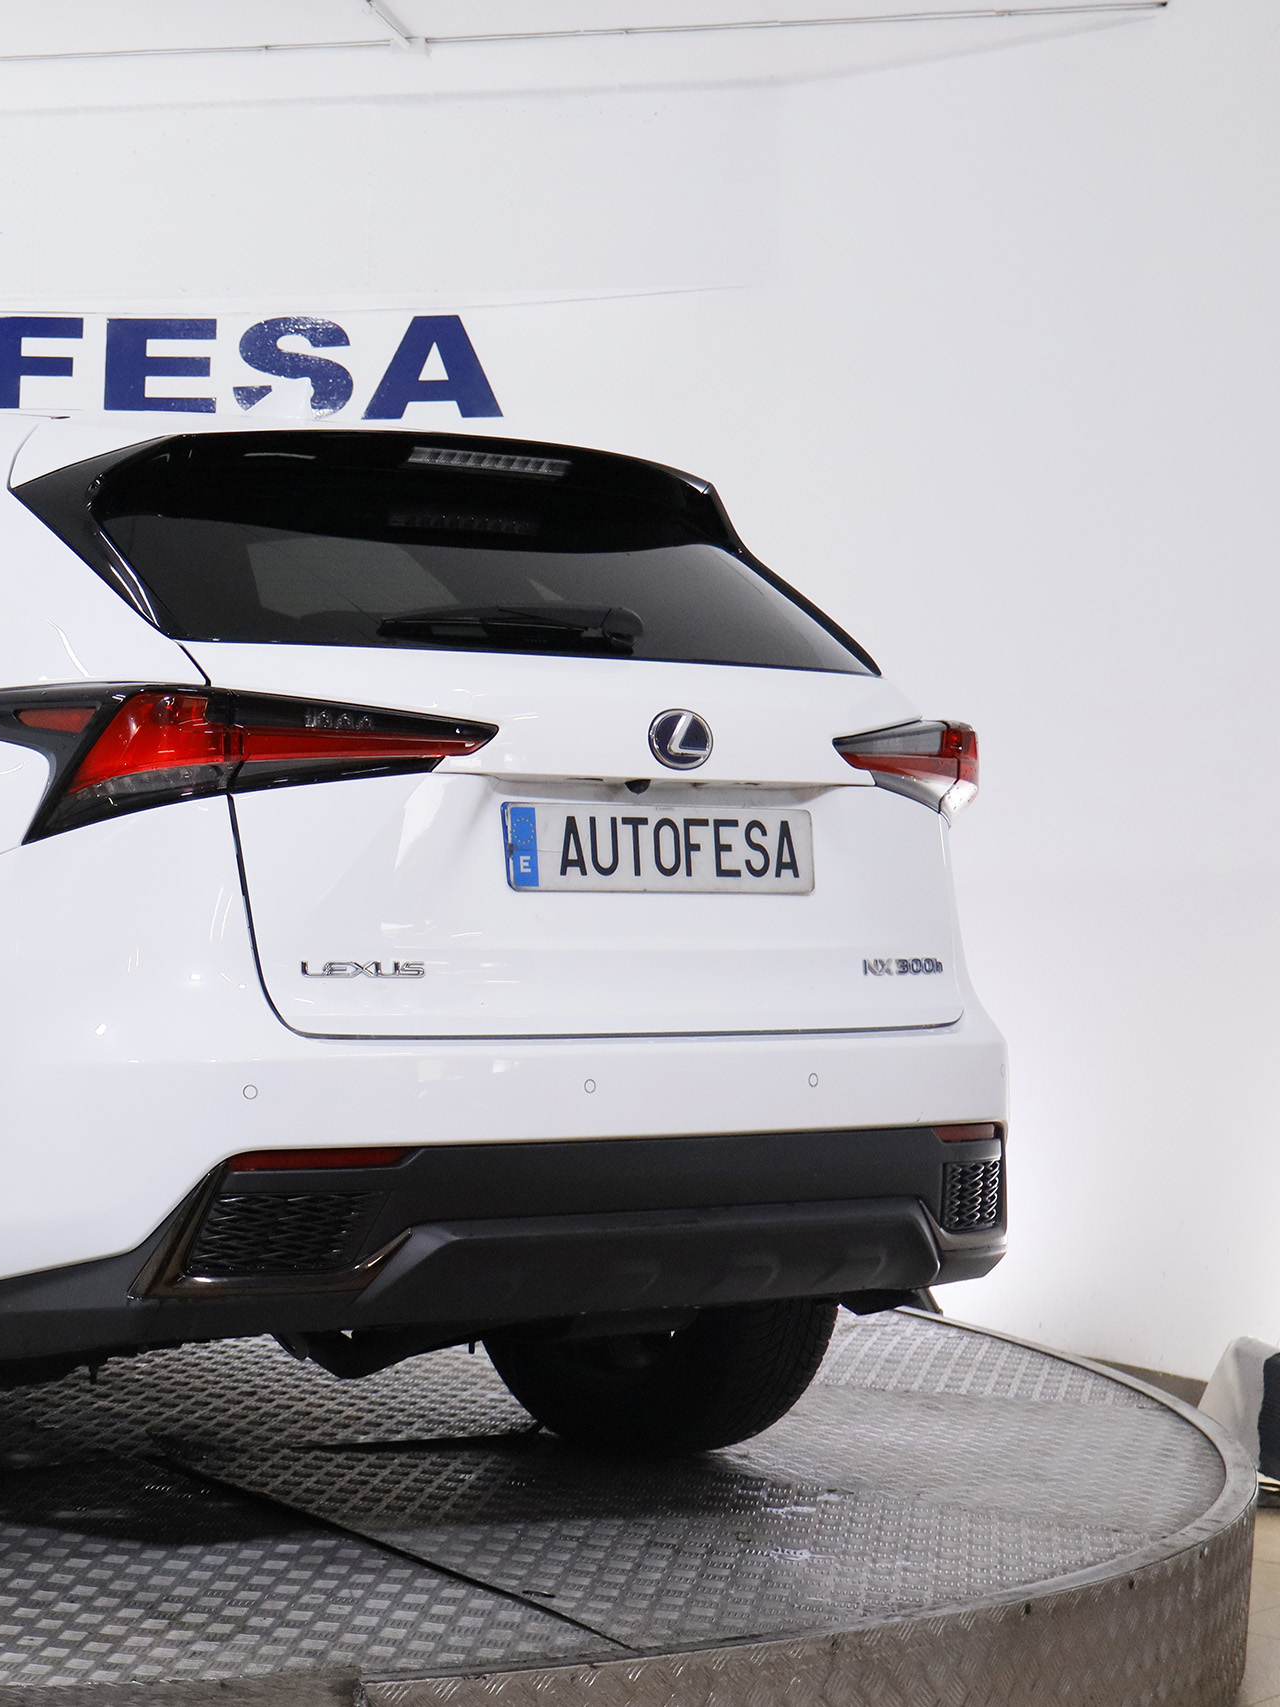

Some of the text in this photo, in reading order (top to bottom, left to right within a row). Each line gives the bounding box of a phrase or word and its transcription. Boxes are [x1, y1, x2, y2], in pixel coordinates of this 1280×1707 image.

[560, 816, 800, 878] AUTOFESA
[519, 855, 533, 873] E
[301, 960, 426, 979] LEXUS
[862, 958, 893, 976] NX
